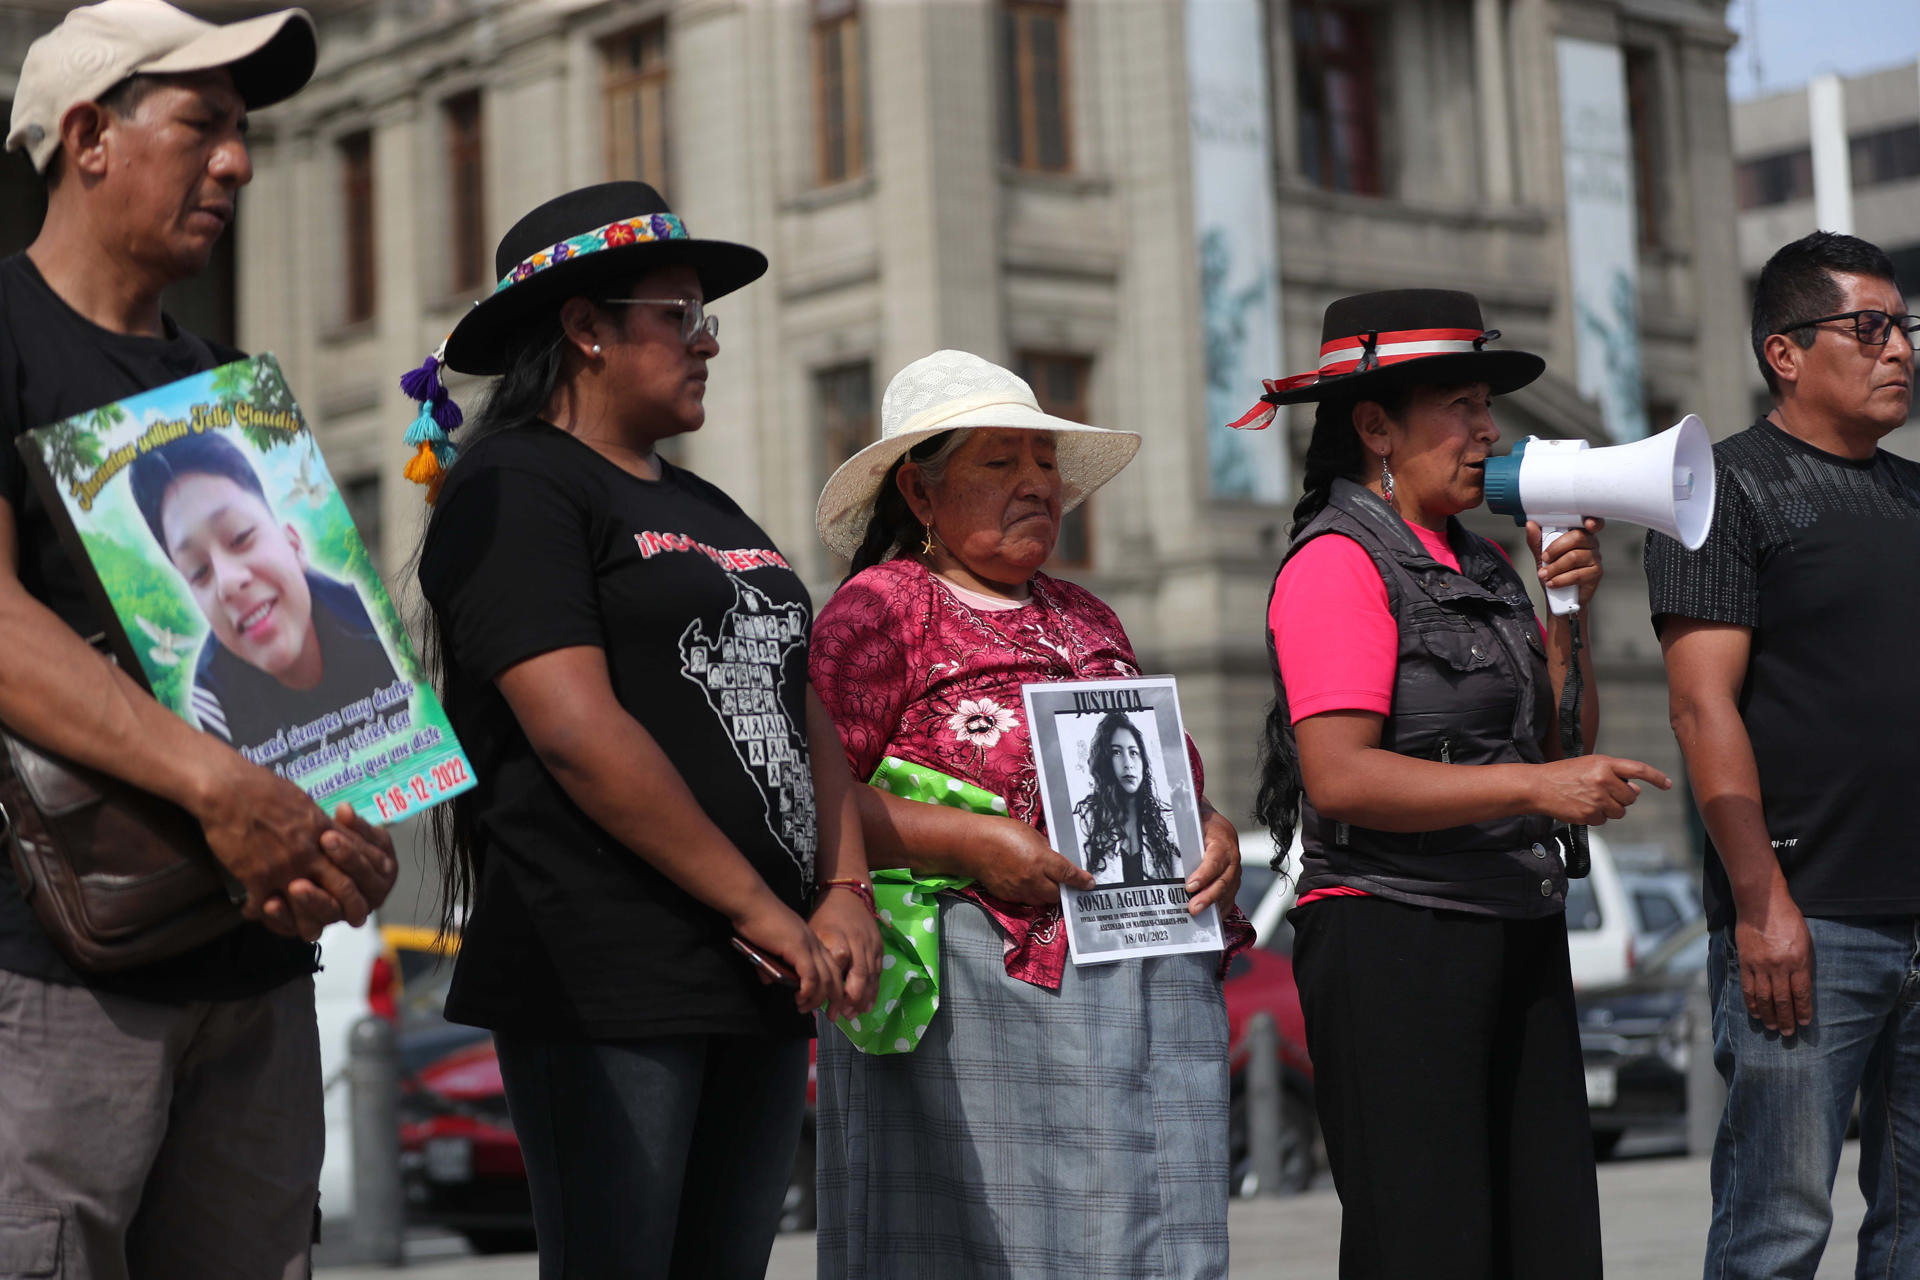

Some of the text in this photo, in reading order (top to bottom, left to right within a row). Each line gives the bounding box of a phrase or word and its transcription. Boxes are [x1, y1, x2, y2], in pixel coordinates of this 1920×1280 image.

[190, 402, 233, 435] Tello
[233, 399, 300, 433] Claudio
[1073, 689, 1145, 718] JUSTICIA
[287, 711, 343, 751] siempre
[340, 697, 376, 728] muy
[286, 733, 340, 781] corazón
[338, 736, 352, 763] y
[387, 709, 412, 734] con
[306, 725, 441, 799] ecuerdos que me diste
[1771, 838, 1799, 848] RI-FIT
[1077, 893, 1113, 912] SONIA
[1116, 888, 1166, 908] AGUILAR
[1124, 930, 1169, 945] 18/01/2023
